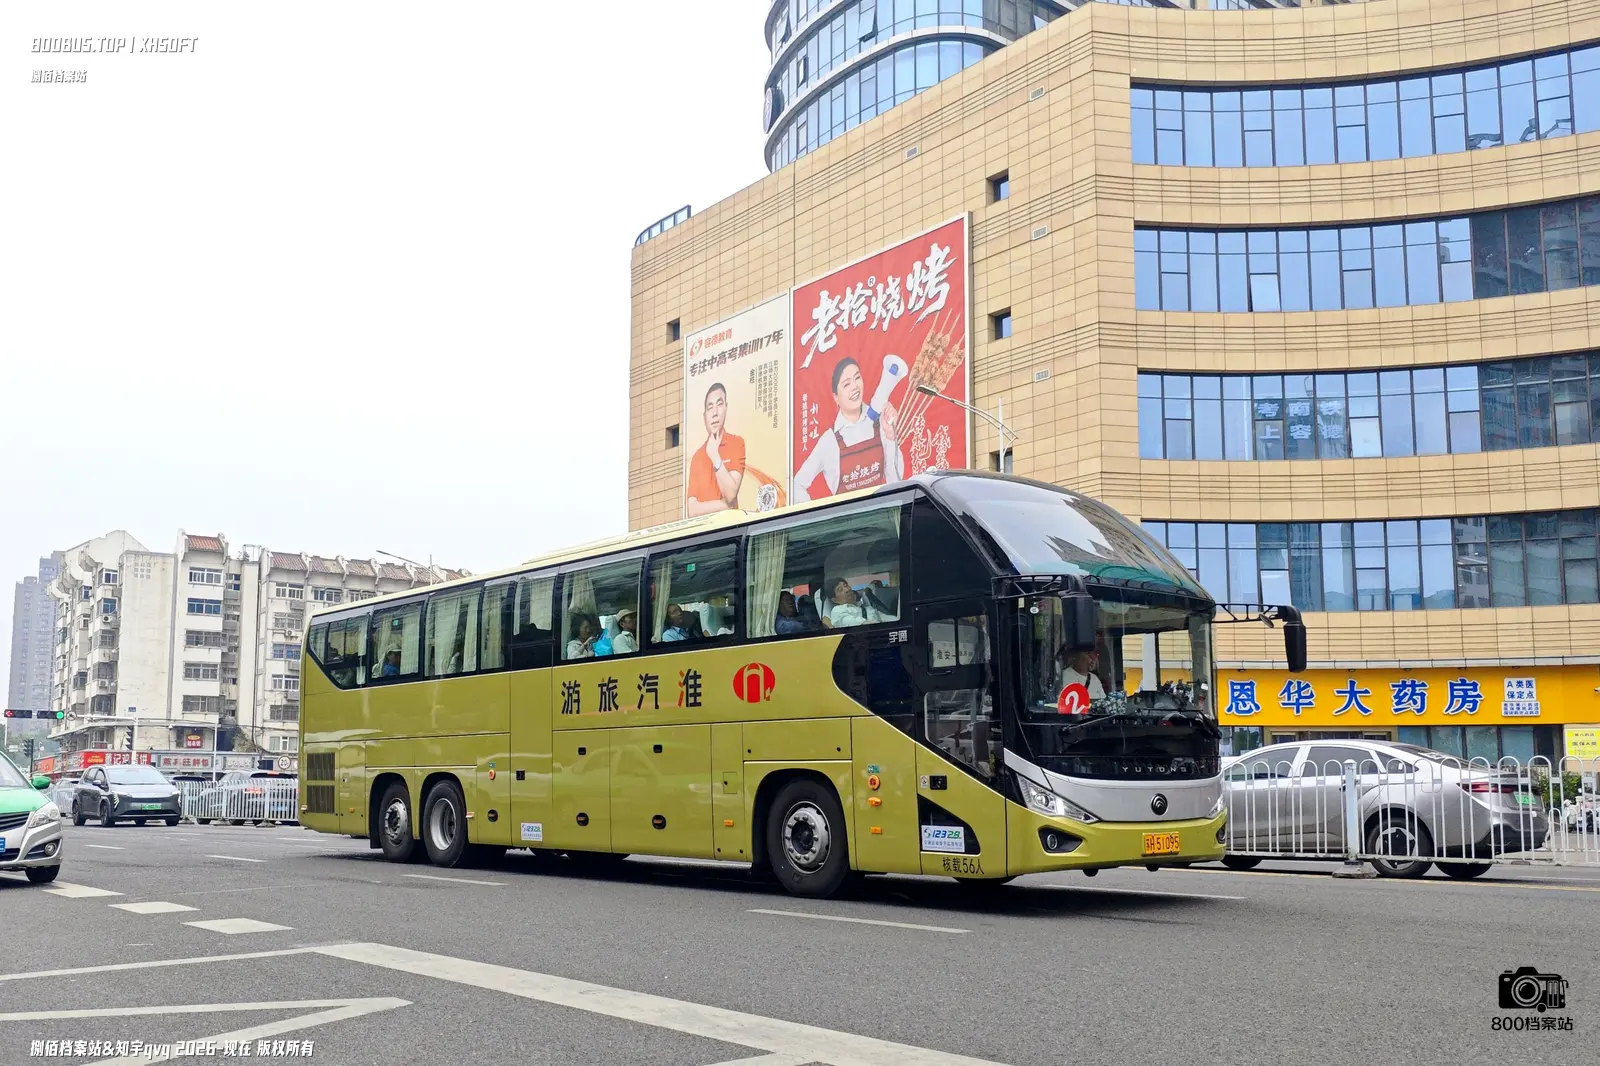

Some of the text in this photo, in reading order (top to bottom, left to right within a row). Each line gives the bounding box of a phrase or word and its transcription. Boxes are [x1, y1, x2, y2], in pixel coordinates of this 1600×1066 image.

[690, 329, 783, 377] 专注中高考集训17年
[888, 630, 908, 643] 宇通
[1225, 677, 1484, 717] 恩华大药房
[1507, 690, 1534, 699] 保定点
[943, 857, 985, 875] 核载56人
